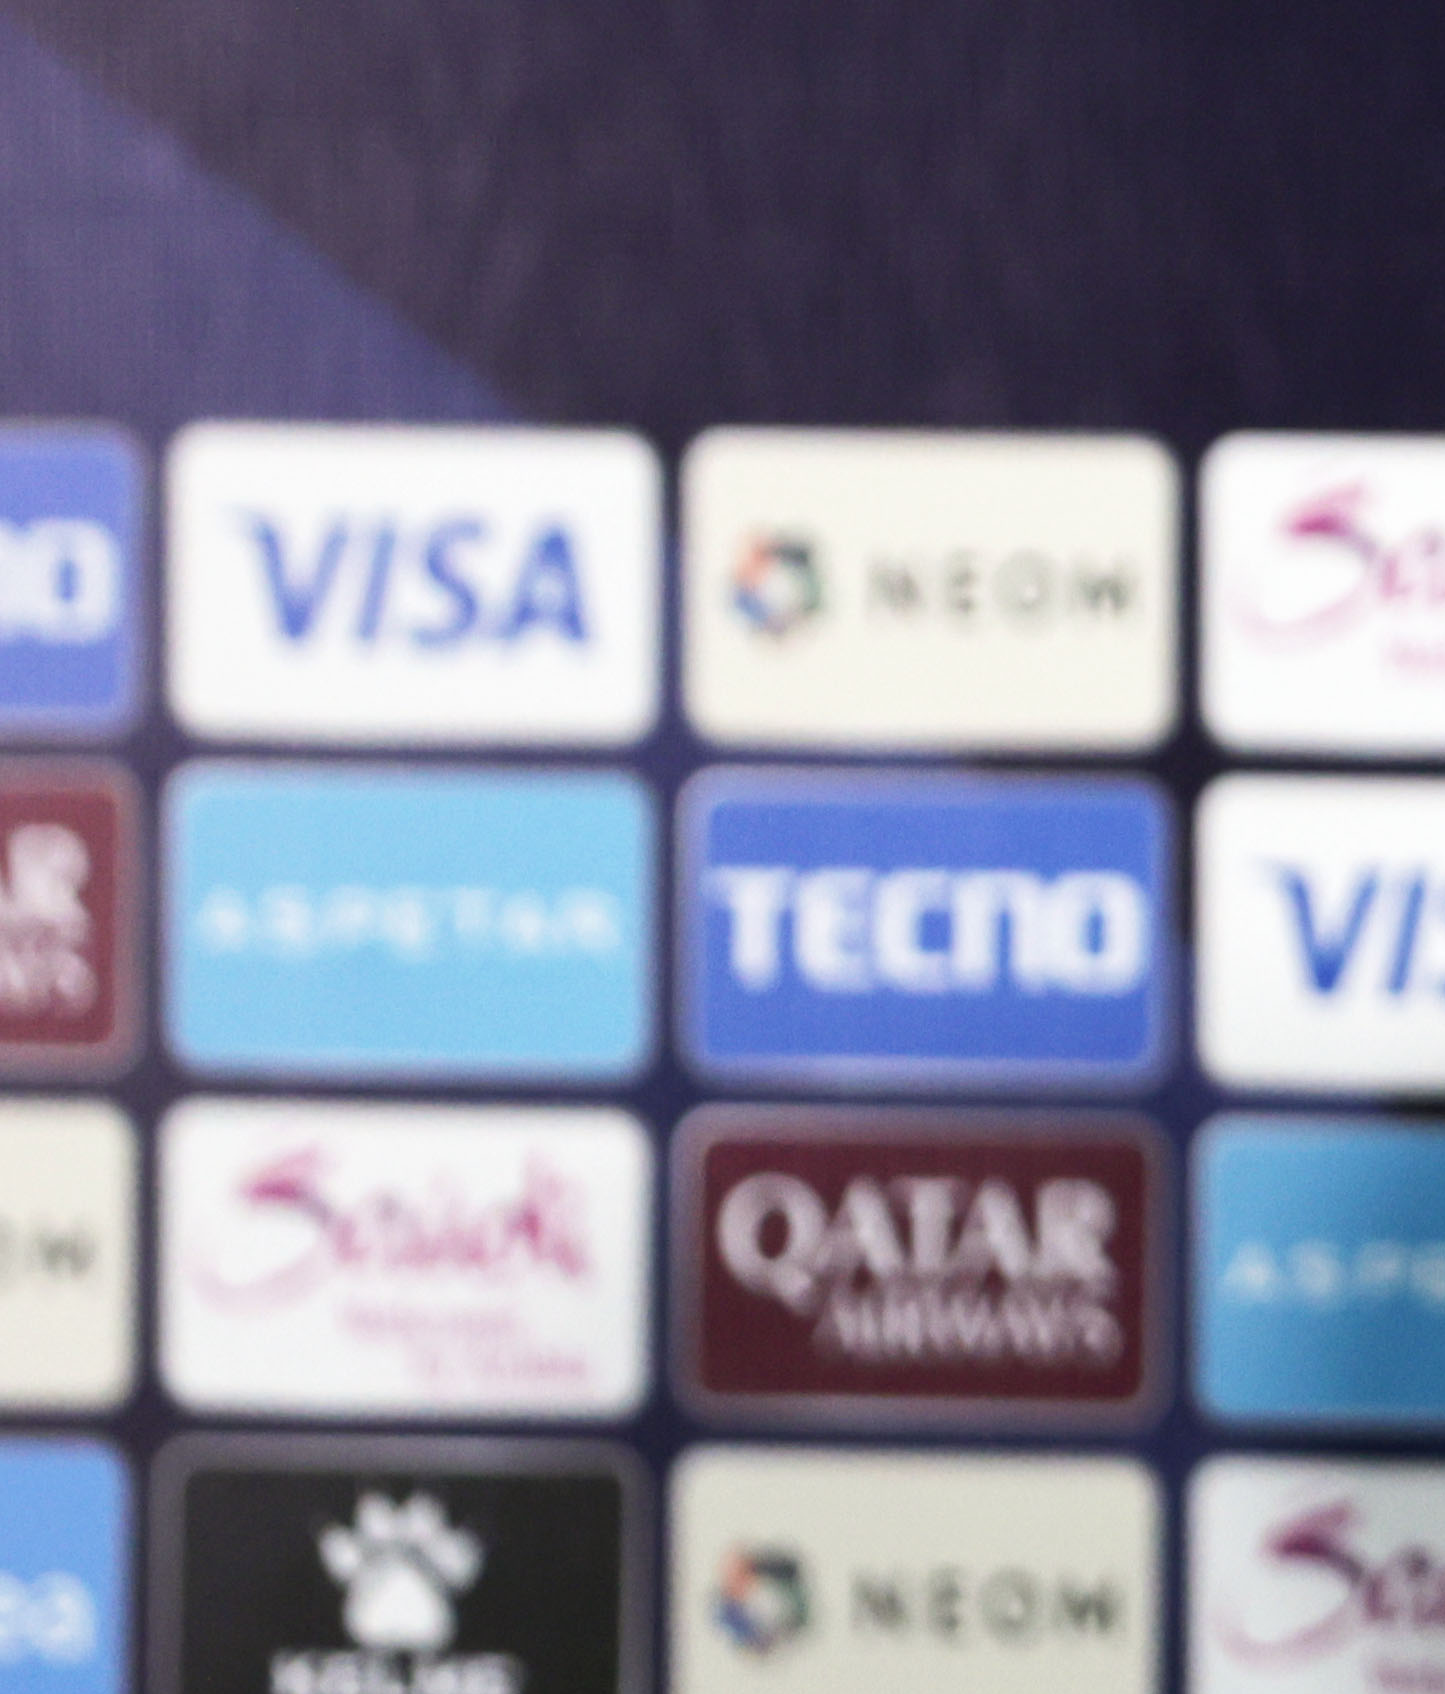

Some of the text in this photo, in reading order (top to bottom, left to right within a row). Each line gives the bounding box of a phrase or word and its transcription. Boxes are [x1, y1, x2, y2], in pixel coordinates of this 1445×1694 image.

[234, 512, 592, 646] VISA
[867, 548, 1142, 625] NEOM
[708, 866, 1150, 995] TECNO
[717, 1172, 1116, 1314] QATAR
[853, 1572, 1120, 1647] NEOM
